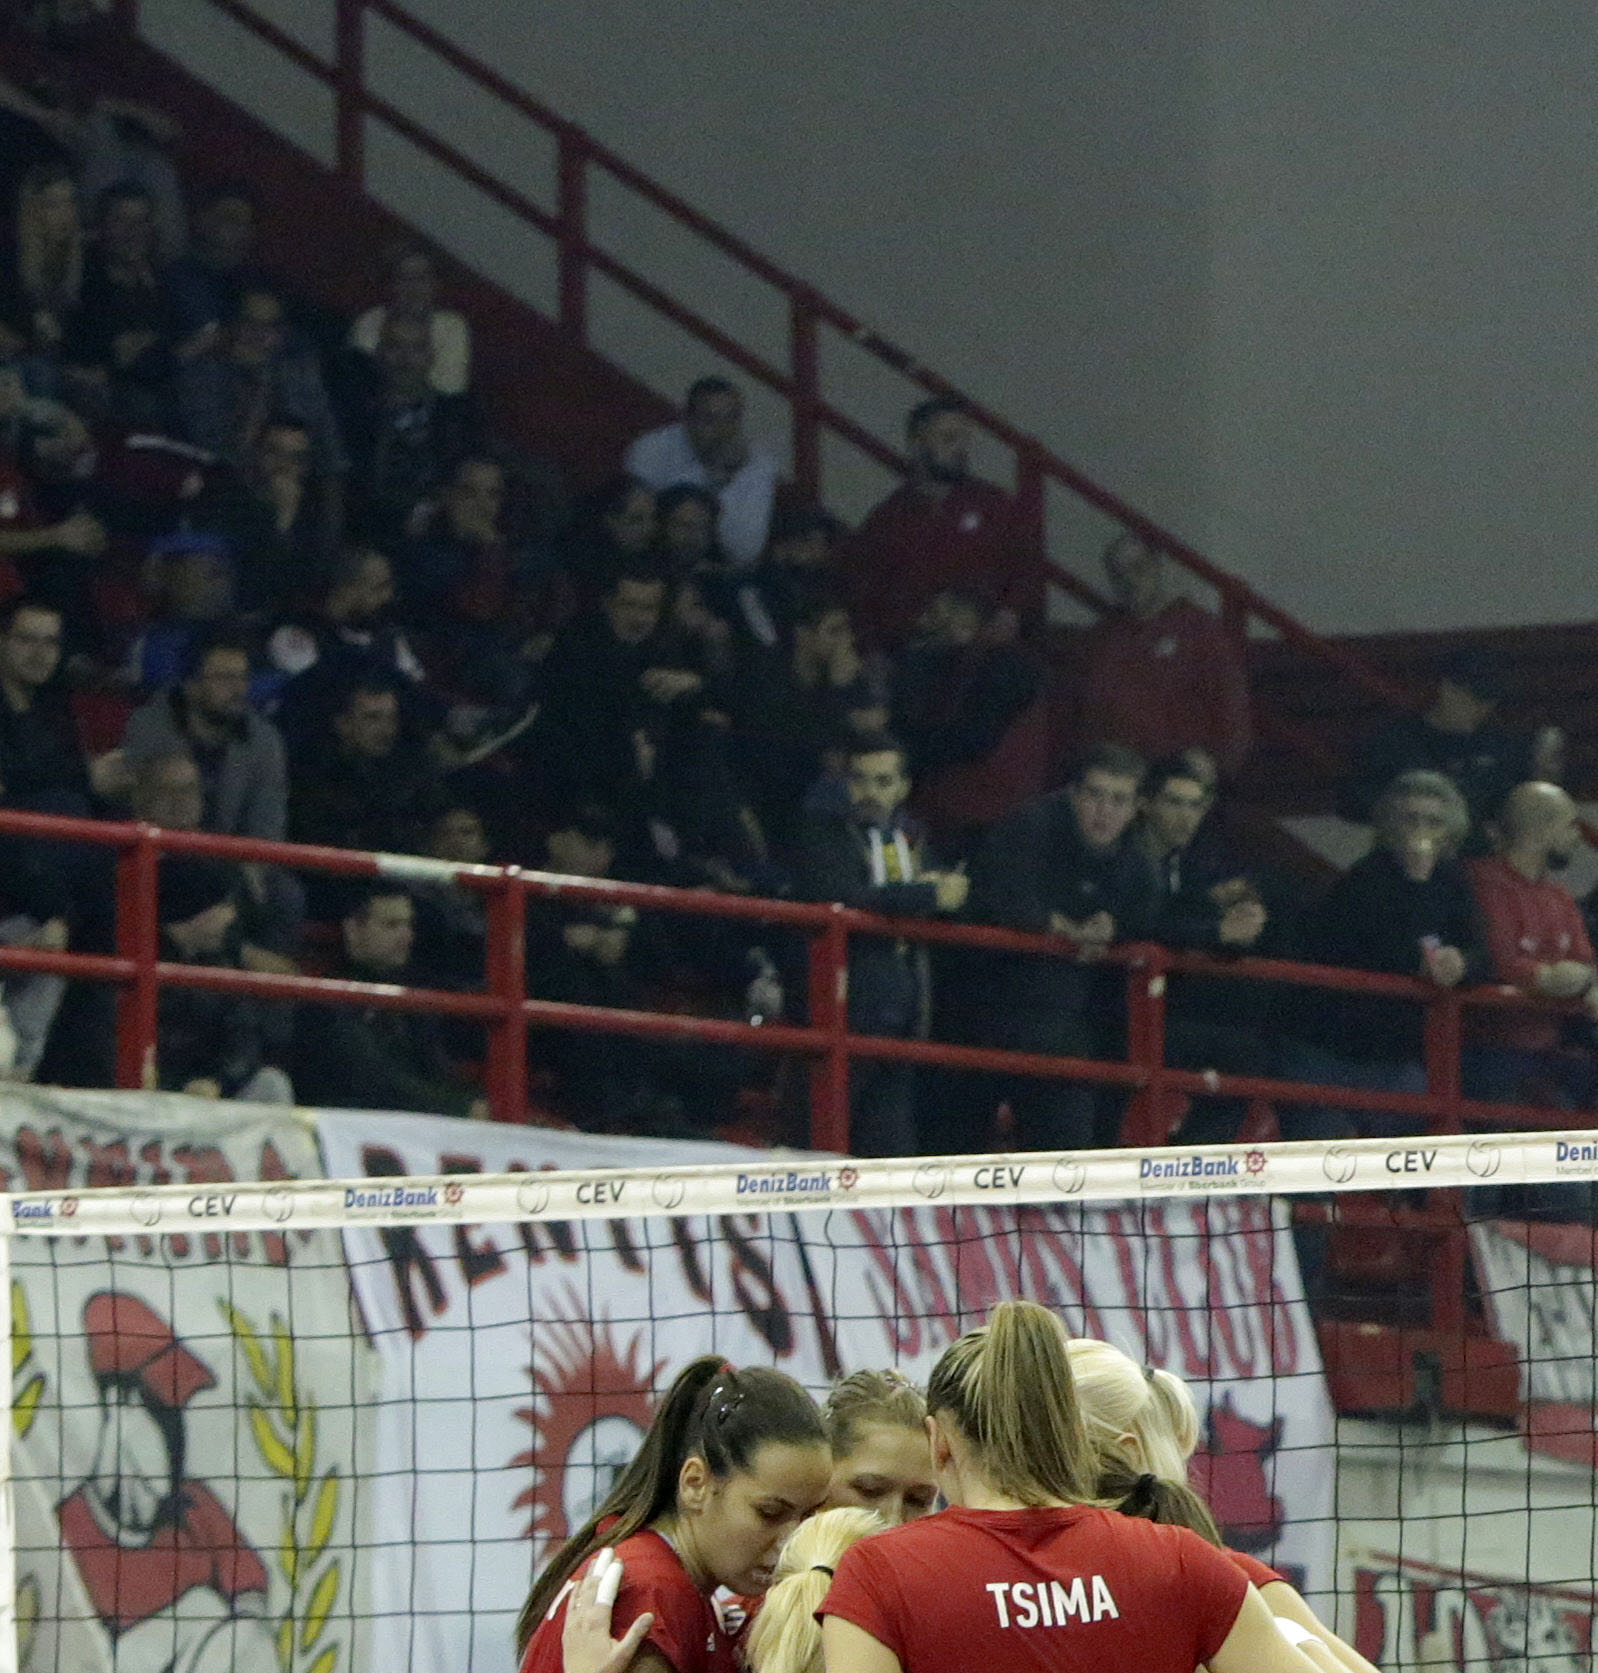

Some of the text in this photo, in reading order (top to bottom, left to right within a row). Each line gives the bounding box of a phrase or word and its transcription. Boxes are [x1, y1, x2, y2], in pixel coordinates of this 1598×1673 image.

[1140, 1156, 1239, 1179] DenizBank
[1385, 1150, 1437, 1173] CEV
[736, 1172, 832, 1194] DenizBank
[974, 1166, 1025, 1190] CEV
[344, 1188, 438, 1209] DenizBank
[576, 1181, 625, 1204] CEV
[188, 1194, 237, 1217] CEV
[985, 1574, 1120, 1629] TSIMA
